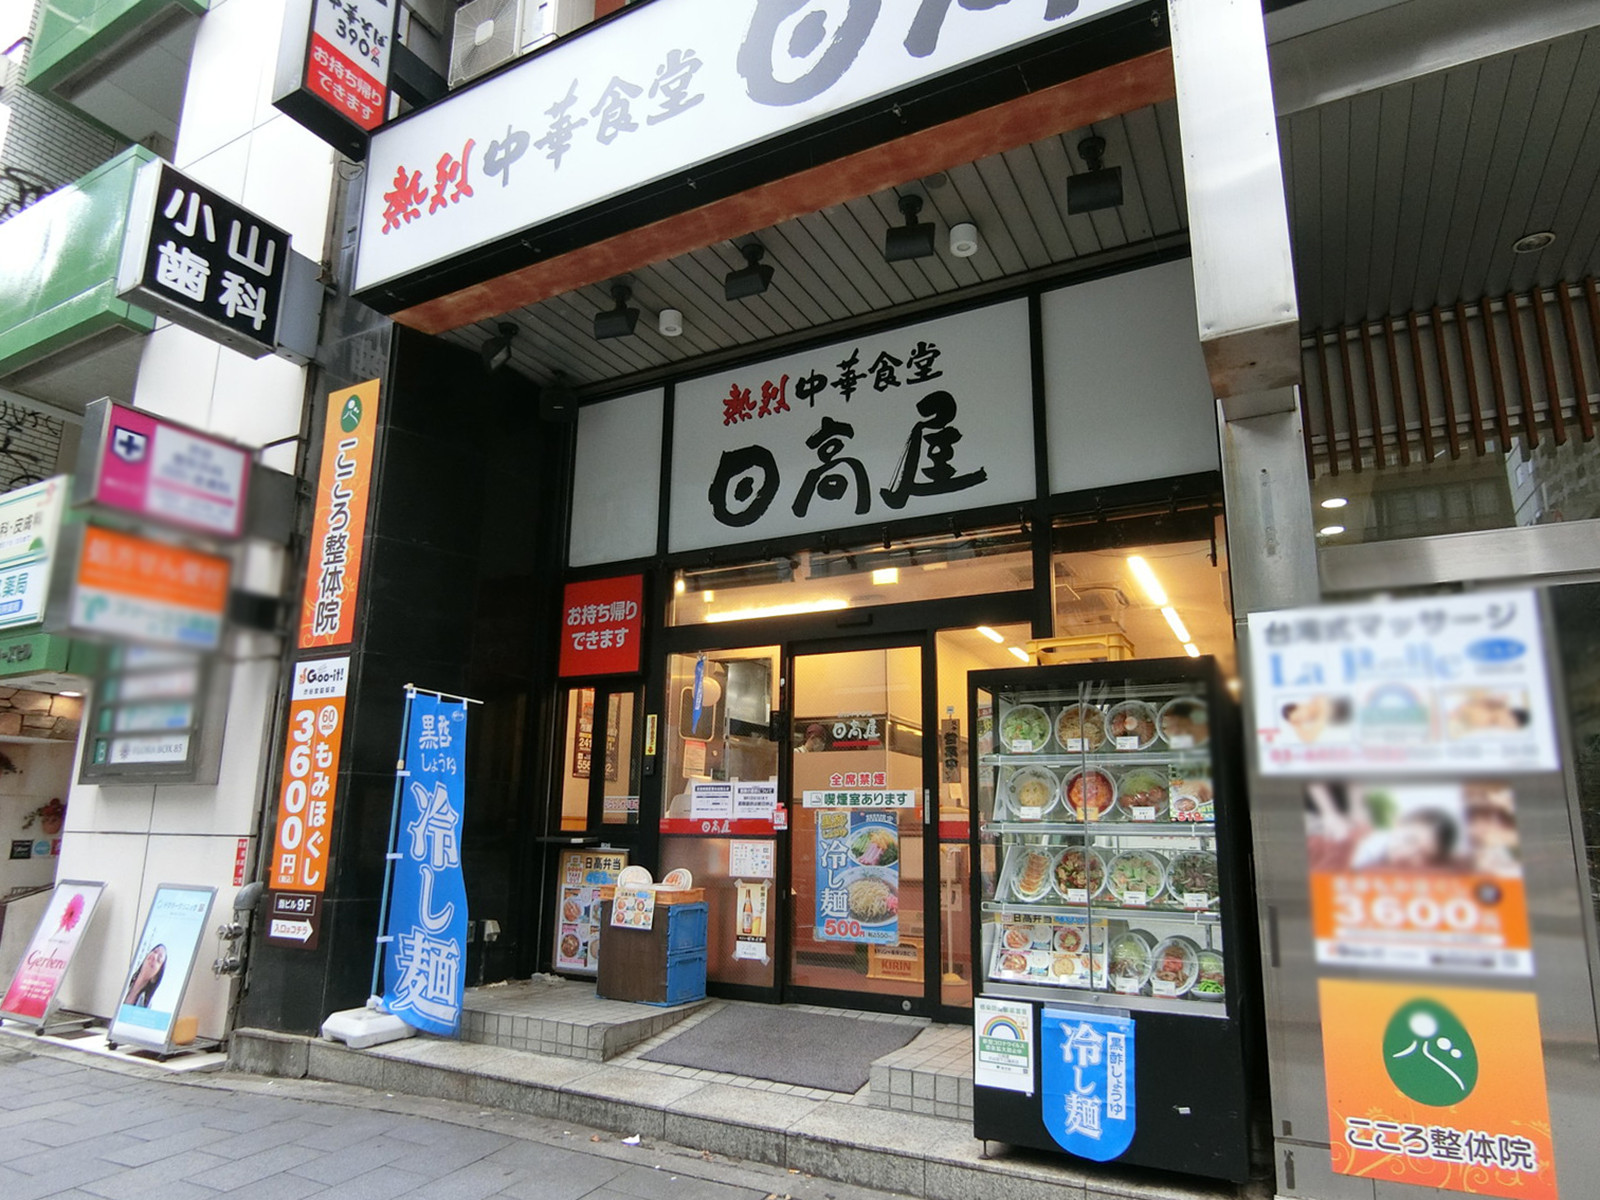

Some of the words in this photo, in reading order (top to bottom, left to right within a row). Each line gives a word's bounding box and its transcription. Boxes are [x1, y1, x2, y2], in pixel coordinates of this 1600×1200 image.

[313, 45, 382, 107] お持ち帰り
[318, 71, 374, 120] できます
[163, 188, 277, 278] 小山
[156, 241, 268, 331] 歯科
[708, 390, 988, 528] 日高屋
[314, 438, 357, 636] こころ整体院
[567, 600, 638, 626] お持ち帰り
[571, 627, 629, 651] できます
[322, 709, 335, 723] 60
[832, 718, 880, 740] 日高屋
[824, 792, 908, 806] 喫煙室あります
[830, 772, 886, 787] 全席禁煙
[303, 741, 333, 887] もみほぐし
[585, 857, 621, 870] 日高弁当
[821, 840, 850, 918] 冷し麺
[389, 780, 461, 1027] 冷し麺
[1013, 913, 1053, 924] 日高弁当
[881, 960, 912, 970] KIRIN
[1060, 1021, 1106, 1141] 冷し麺
[1346, 1117, 1539, 1173] こころ整体院
